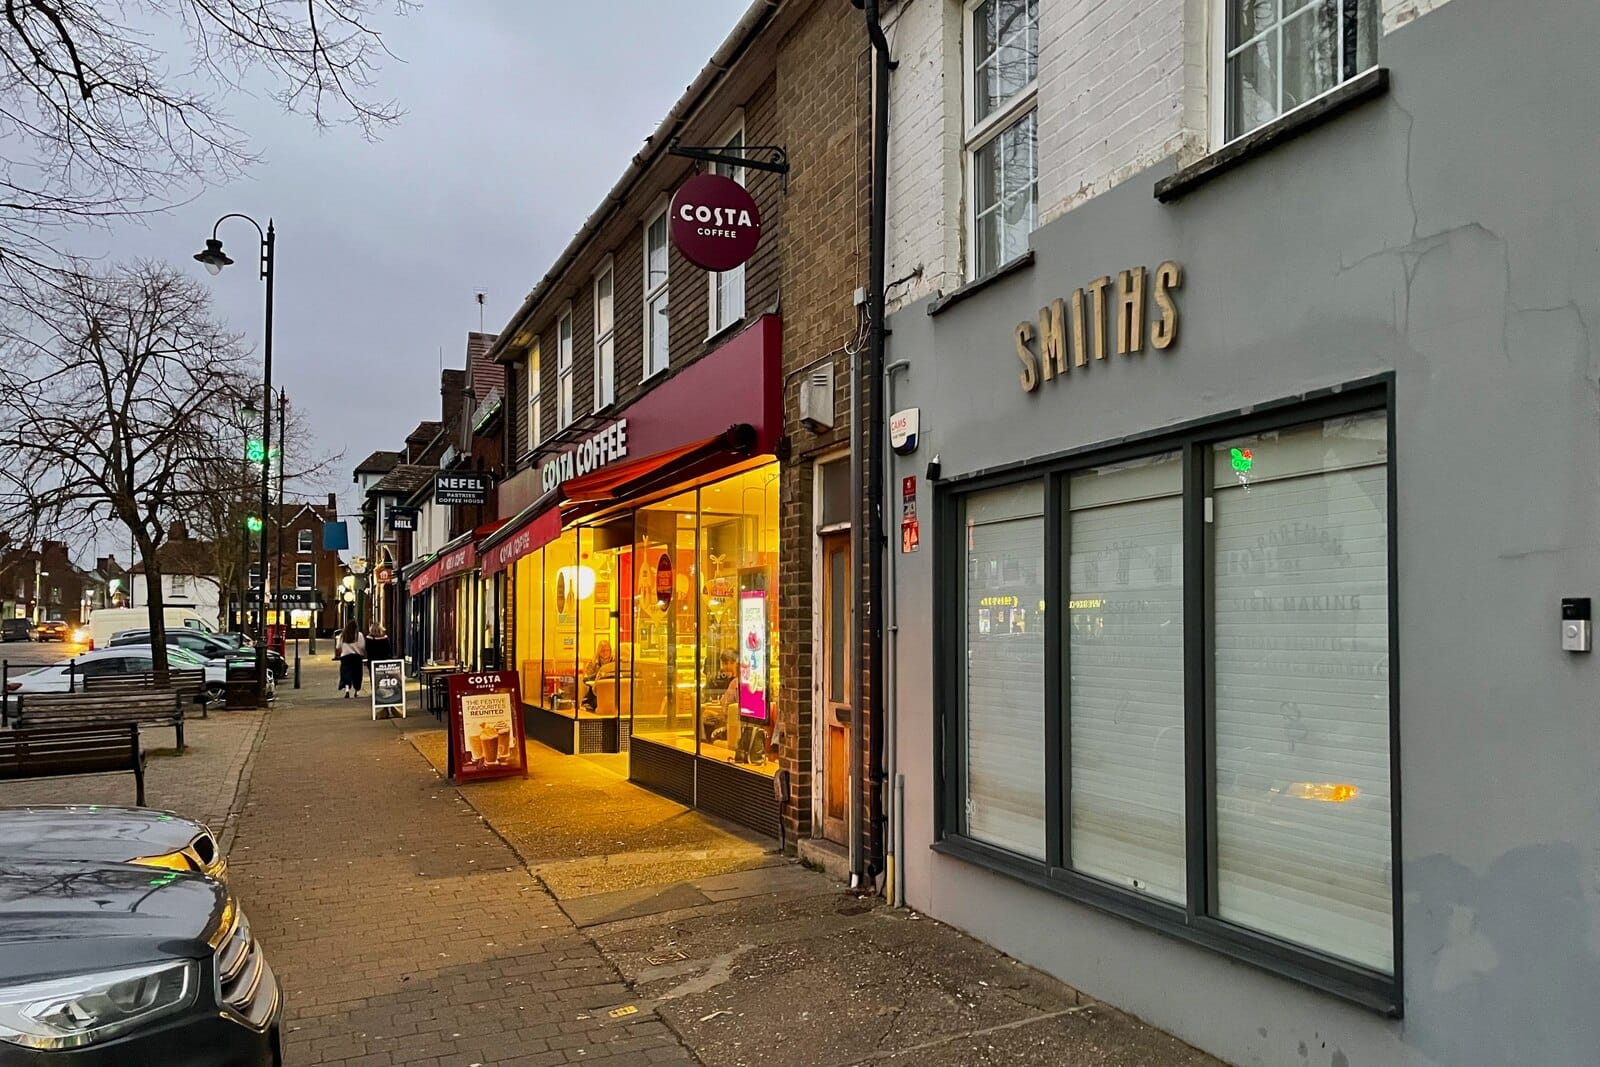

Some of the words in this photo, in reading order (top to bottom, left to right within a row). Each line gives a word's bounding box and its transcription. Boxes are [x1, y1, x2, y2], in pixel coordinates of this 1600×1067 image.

[680, 204, 751, 227] COSTA
[697, 228, 737, 238] COFFEE
[1015, 260, 1182, 393] SMITHS
[542, 450, 574, 493] COSTA
[576, 418, 627, 477] COFFEE
[438, 478, 484, 490] NEFEL
[394, 520, 412, 528] HILL
[379, 678, 398, 687] £10
[468, 675, 501, 684] COSTA
